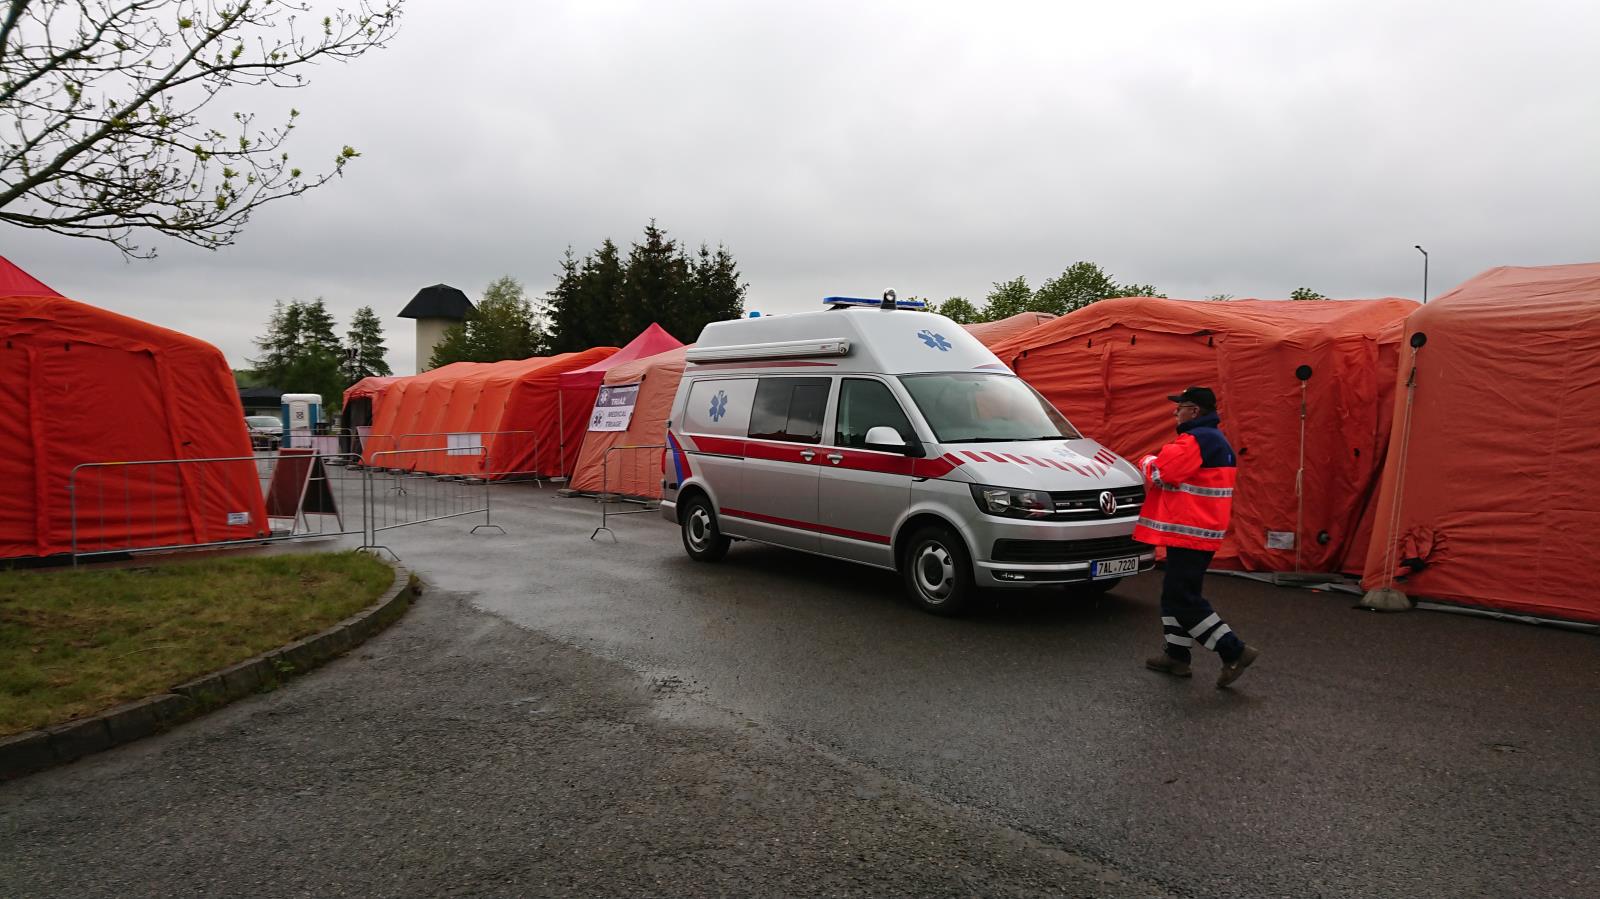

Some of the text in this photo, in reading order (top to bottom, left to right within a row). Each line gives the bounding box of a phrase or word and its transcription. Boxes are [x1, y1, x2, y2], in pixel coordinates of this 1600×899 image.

[608, 410, 627, 418] MEDICAL
[605, 420, 622, 428] TRIAGE
[1098, 558, 1136, 575] 7AL 7220
